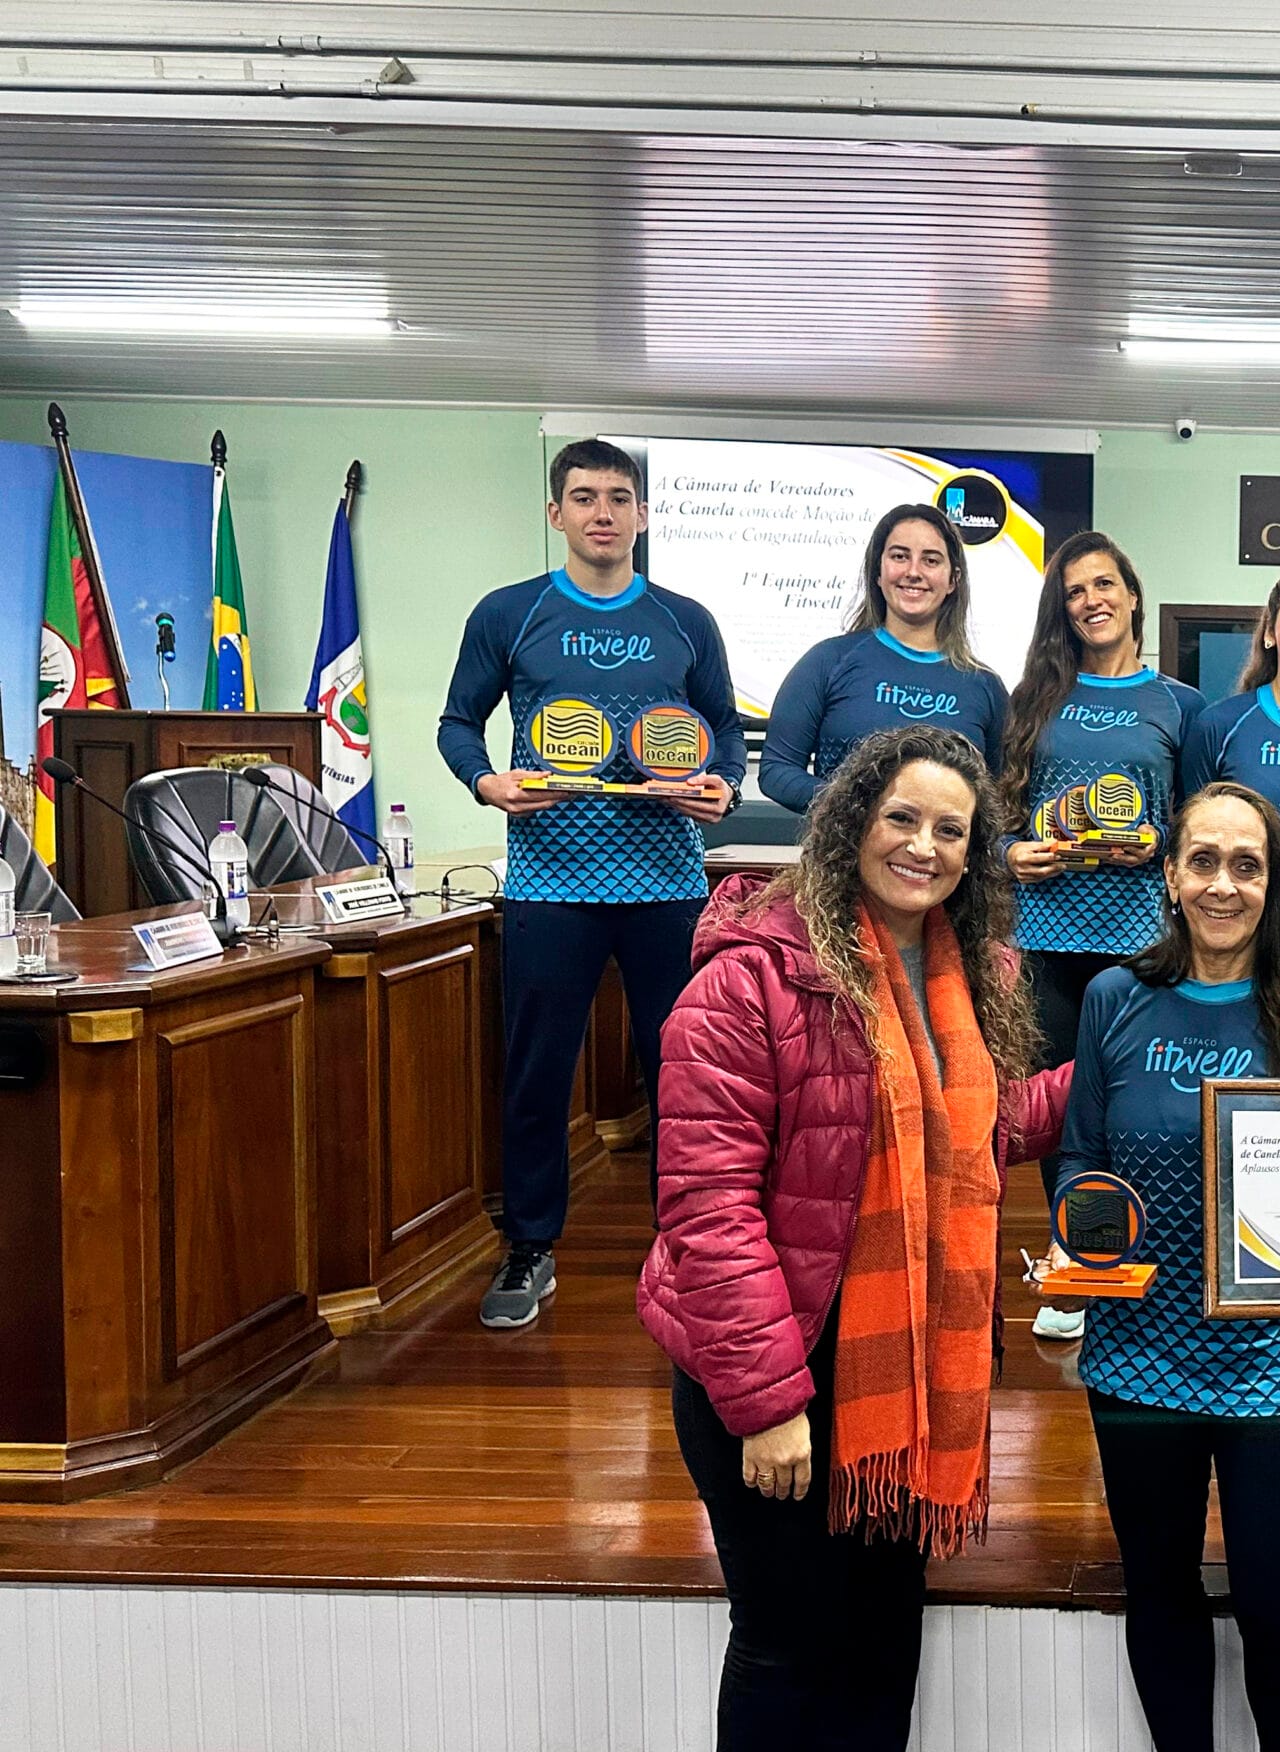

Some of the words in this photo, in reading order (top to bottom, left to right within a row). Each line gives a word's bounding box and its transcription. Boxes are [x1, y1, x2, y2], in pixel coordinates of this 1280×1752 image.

[655, 476, 667, 491] A
[674, 475, 738, 493] Câmara
[744, 479, 762, 494] de
[769, 480, 855, 497] Vereadores
[655, 499, 673, 515] de
[679, 500, 735, 516] Canela
[739, 504, 798, 520] concede
[803, 504, 854, 524] Moção
[858, 507, 876, 523] de
[655, 523, 724, 544] Aplausos
[729, 530, 737, 541] e
[742, 526, 857, 547] Congratulações
[762, 572, 821, 591] Equipe
[826, 575, 846, 590] de
[784, 594, 843, 610] Fitwell
[561, 630, 656, 670] fitwell
[876, 682, 960, 719] fitwell
[1060, 703, 1139, 732] fitwell
[546, 743, 600, 757] ocean
[646, 750, 697, 763] ocean
[1099, 806, 1134, 817] ocean
[1145, 1037, 1254, 1092] fitwell
[1240, 1136, 1248, 1145] A
[1240, 1149, 1251, 1159] de
[1240, 1163, 1279, 1175] Aplausos
